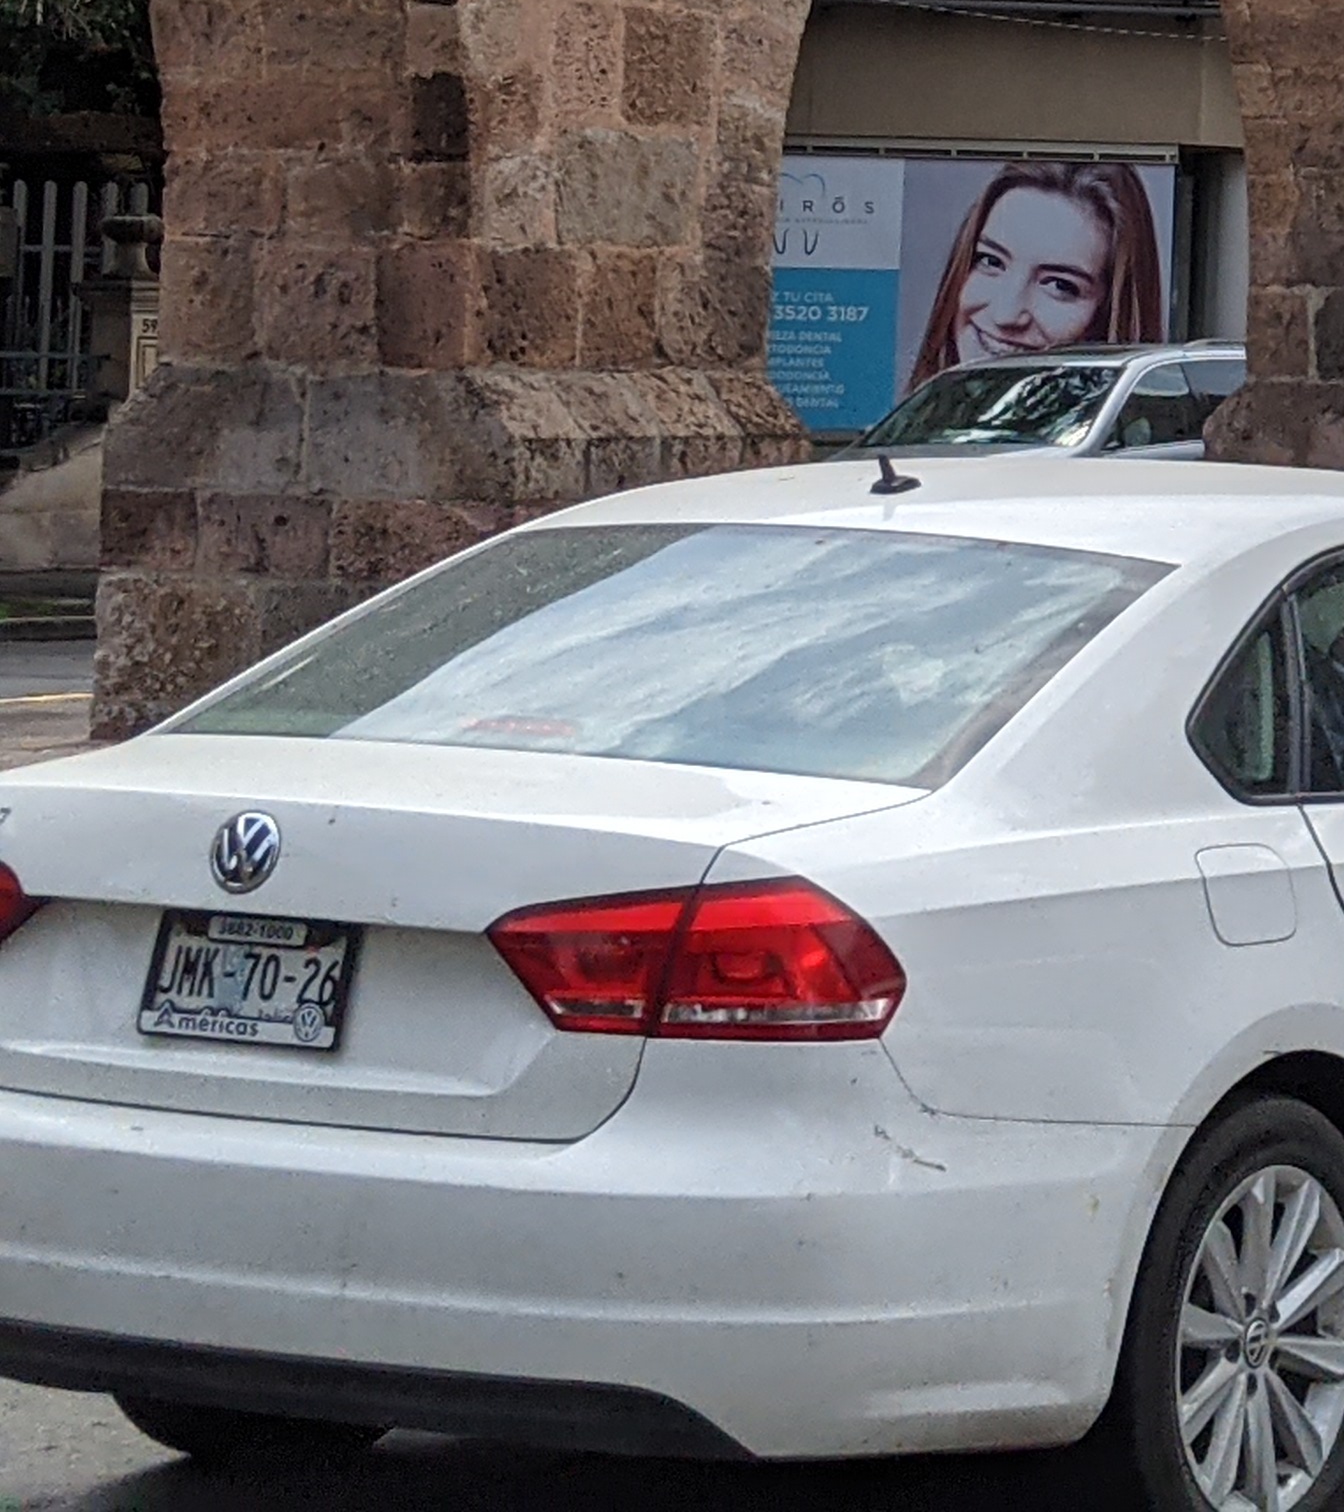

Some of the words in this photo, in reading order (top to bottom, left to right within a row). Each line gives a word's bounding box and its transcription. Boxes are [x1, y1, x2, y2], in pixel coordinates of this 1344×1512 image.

[783, 292, 800, 302] TU
[804, 292, 834, 304] CITA
[773, 305, 822, 320] 3520
[827, 306, 870, 322] 3187
[157, 945, 341, 1006] JMK-70-26
